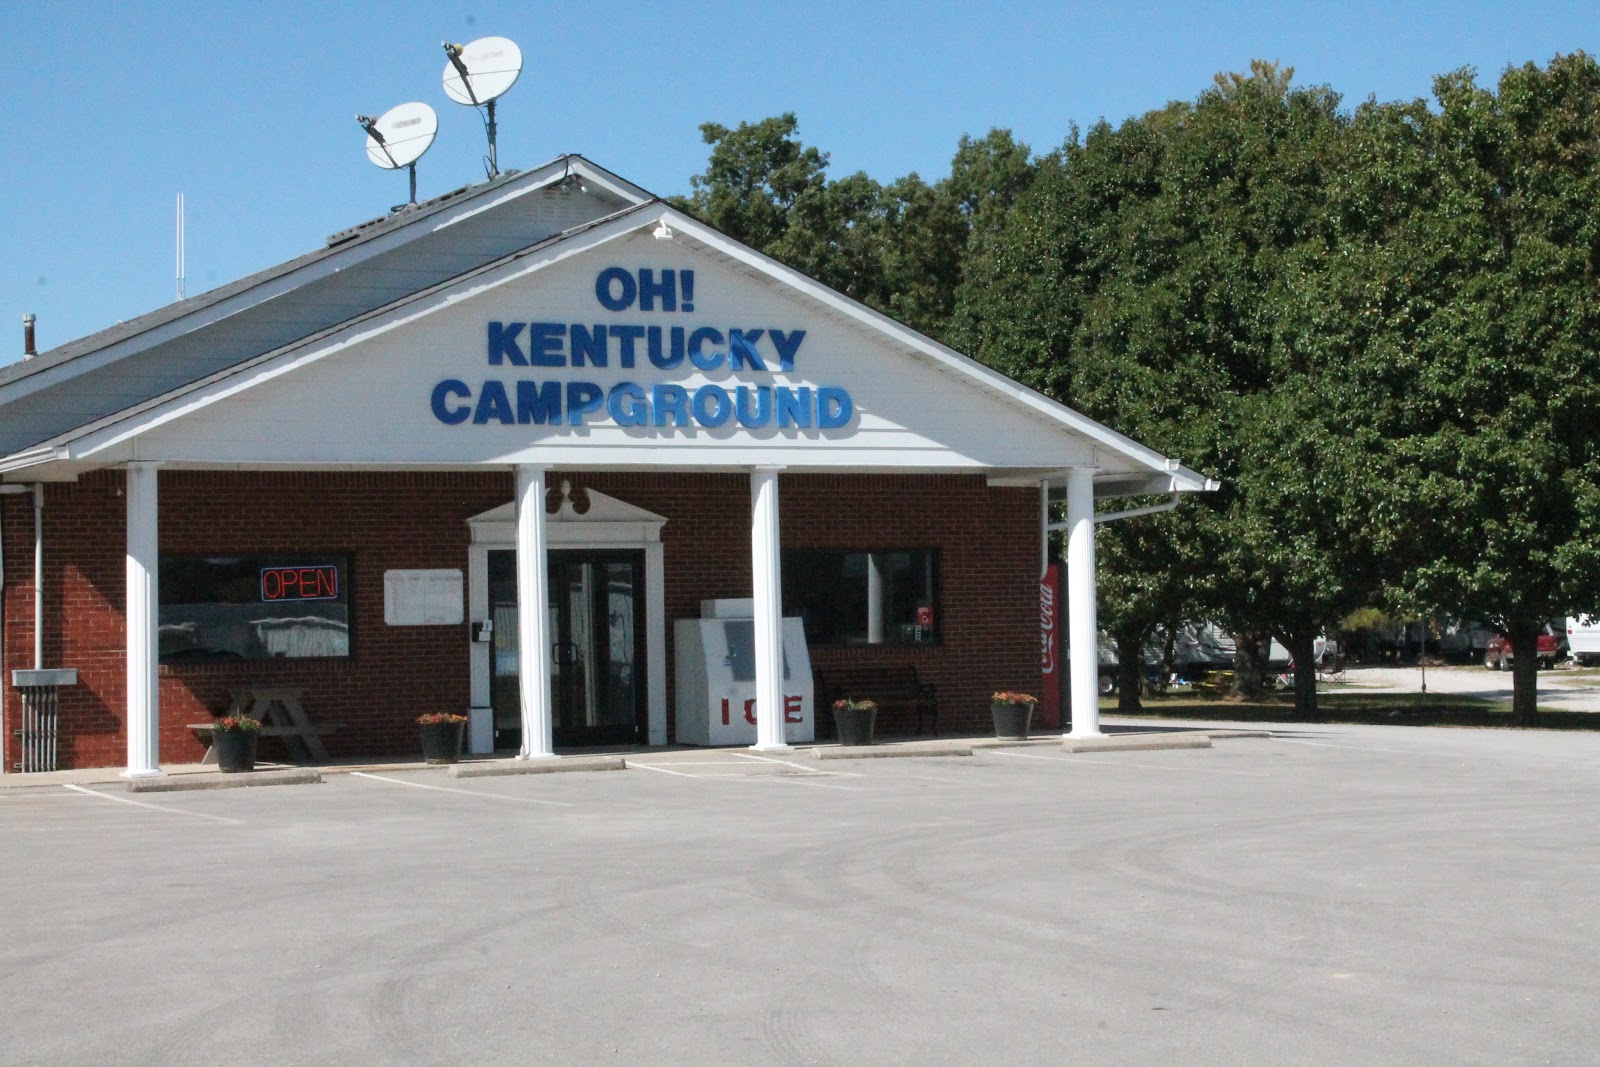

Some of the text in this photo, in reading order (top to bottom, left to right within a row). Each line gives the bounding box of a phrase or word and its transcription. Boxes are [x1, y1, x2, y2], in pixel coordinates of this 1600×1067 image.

[596, 267, 695, 312] OH!
[487, 322, 807, 372] KENTUCKY
[430, 379, 854, 430] CAMPGROUND
[264, 569, 334, 599] OPEN
